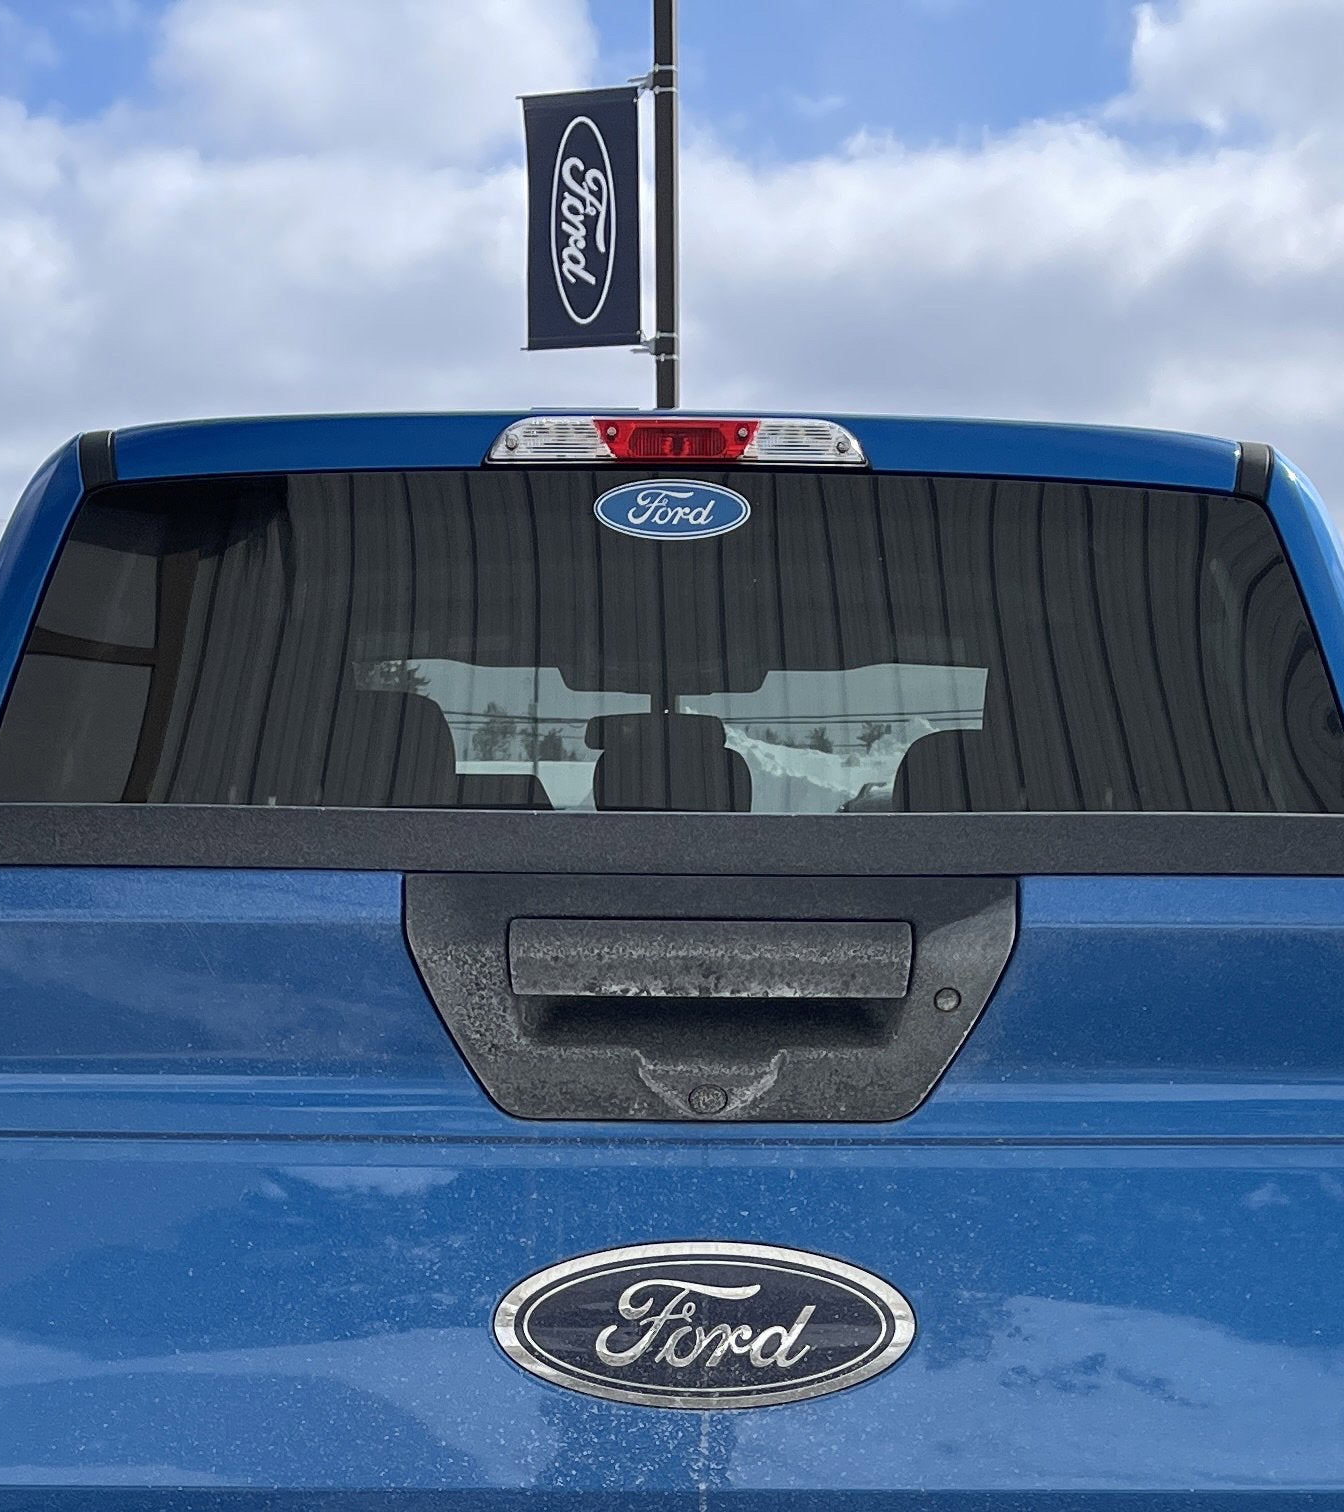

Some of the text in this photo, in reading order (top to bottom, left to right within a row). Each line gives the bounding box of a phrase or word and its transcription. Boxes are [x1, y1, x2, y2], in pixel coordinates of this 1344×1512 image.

[560, 156, 607, 286] Ford
[627, 489, 716, 525] Ford
[595, 1278, 817, 1368] Ford
